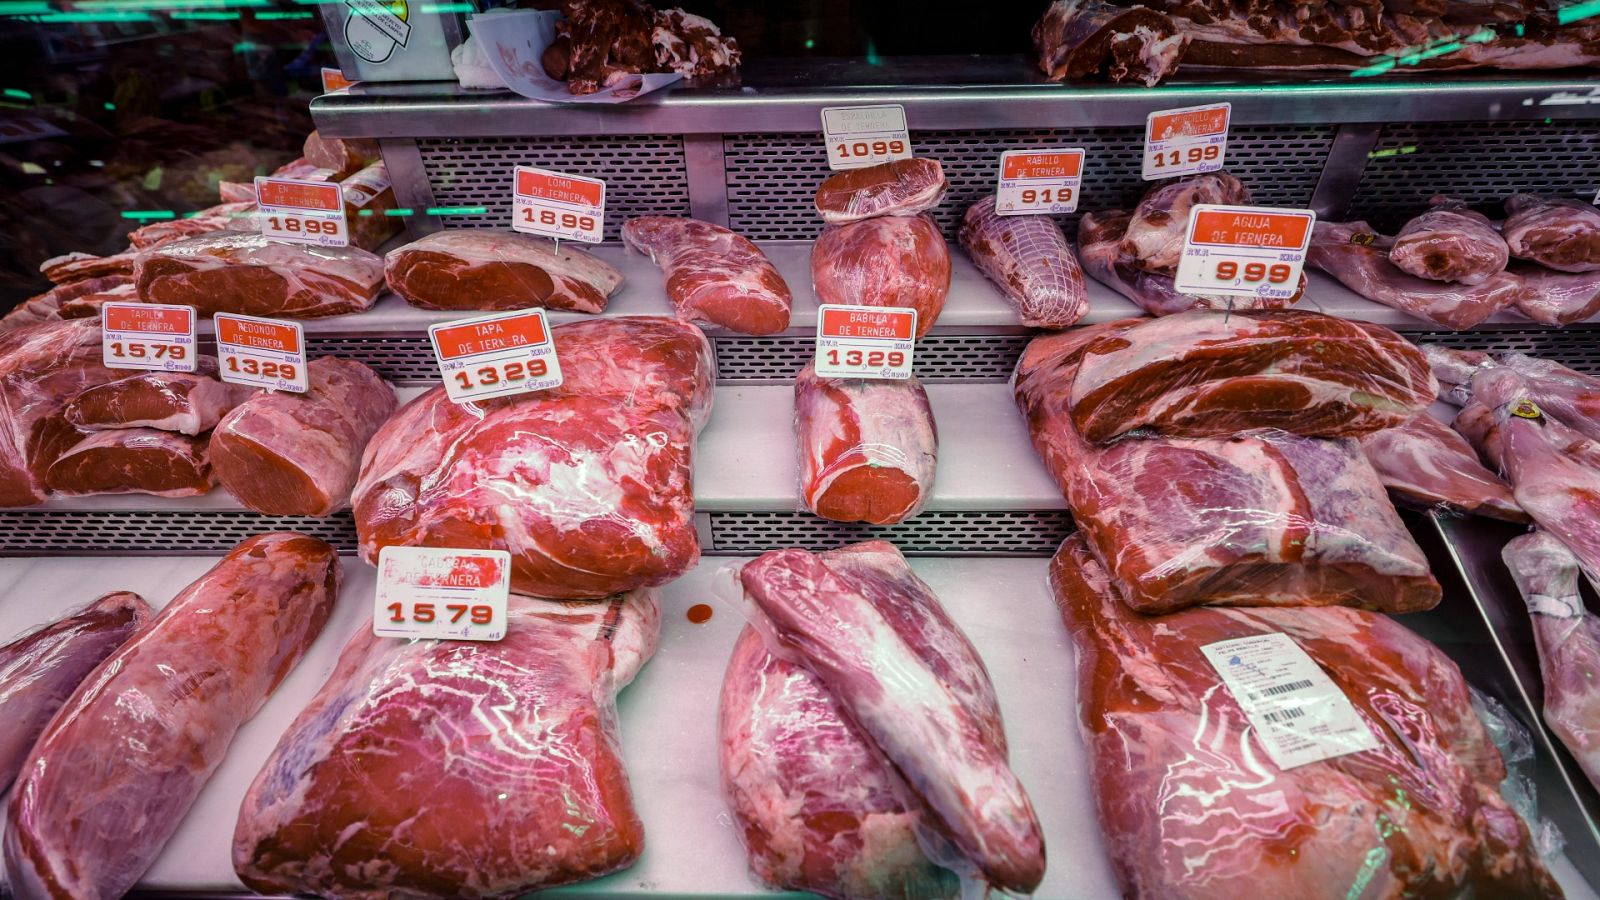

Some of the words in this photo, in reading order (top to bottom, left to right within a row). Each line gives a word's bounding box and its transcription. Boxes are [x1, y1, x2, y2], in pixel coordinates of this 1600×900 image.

[1026, 156, 1059, 165] RABILLO
[1017, 168, 1028, 177] DE
[1031, 167, 1065, 176] TERNERA
[547, 178, 572, 189] LOMO
[532, 186, 543, 196] DE
[547, 189, 585, 203] TERNERA
[1232, 216, 1270, 229] AGUJA
[1211, 230, 1228, 243] DE
[1234, 231, 1284, 245] TERNERA
[850, 313, 888, 324] BABILLA
[121, 321, 133, 330] DE
[138, 321, 175, 332] TERNERA
[237, 321, 276, 336] REDONDO
[475, 323, 504, 337] TAPA
[839, 326, 851, 335] DE
[857, 326, 896, 337] TERNERA
[233, 333, 244, 344] DE
[248, 335, 284, 349] TERNERA
[458, 342, 474, 355] DE
[479, 334, 528, 351] TERNRA
